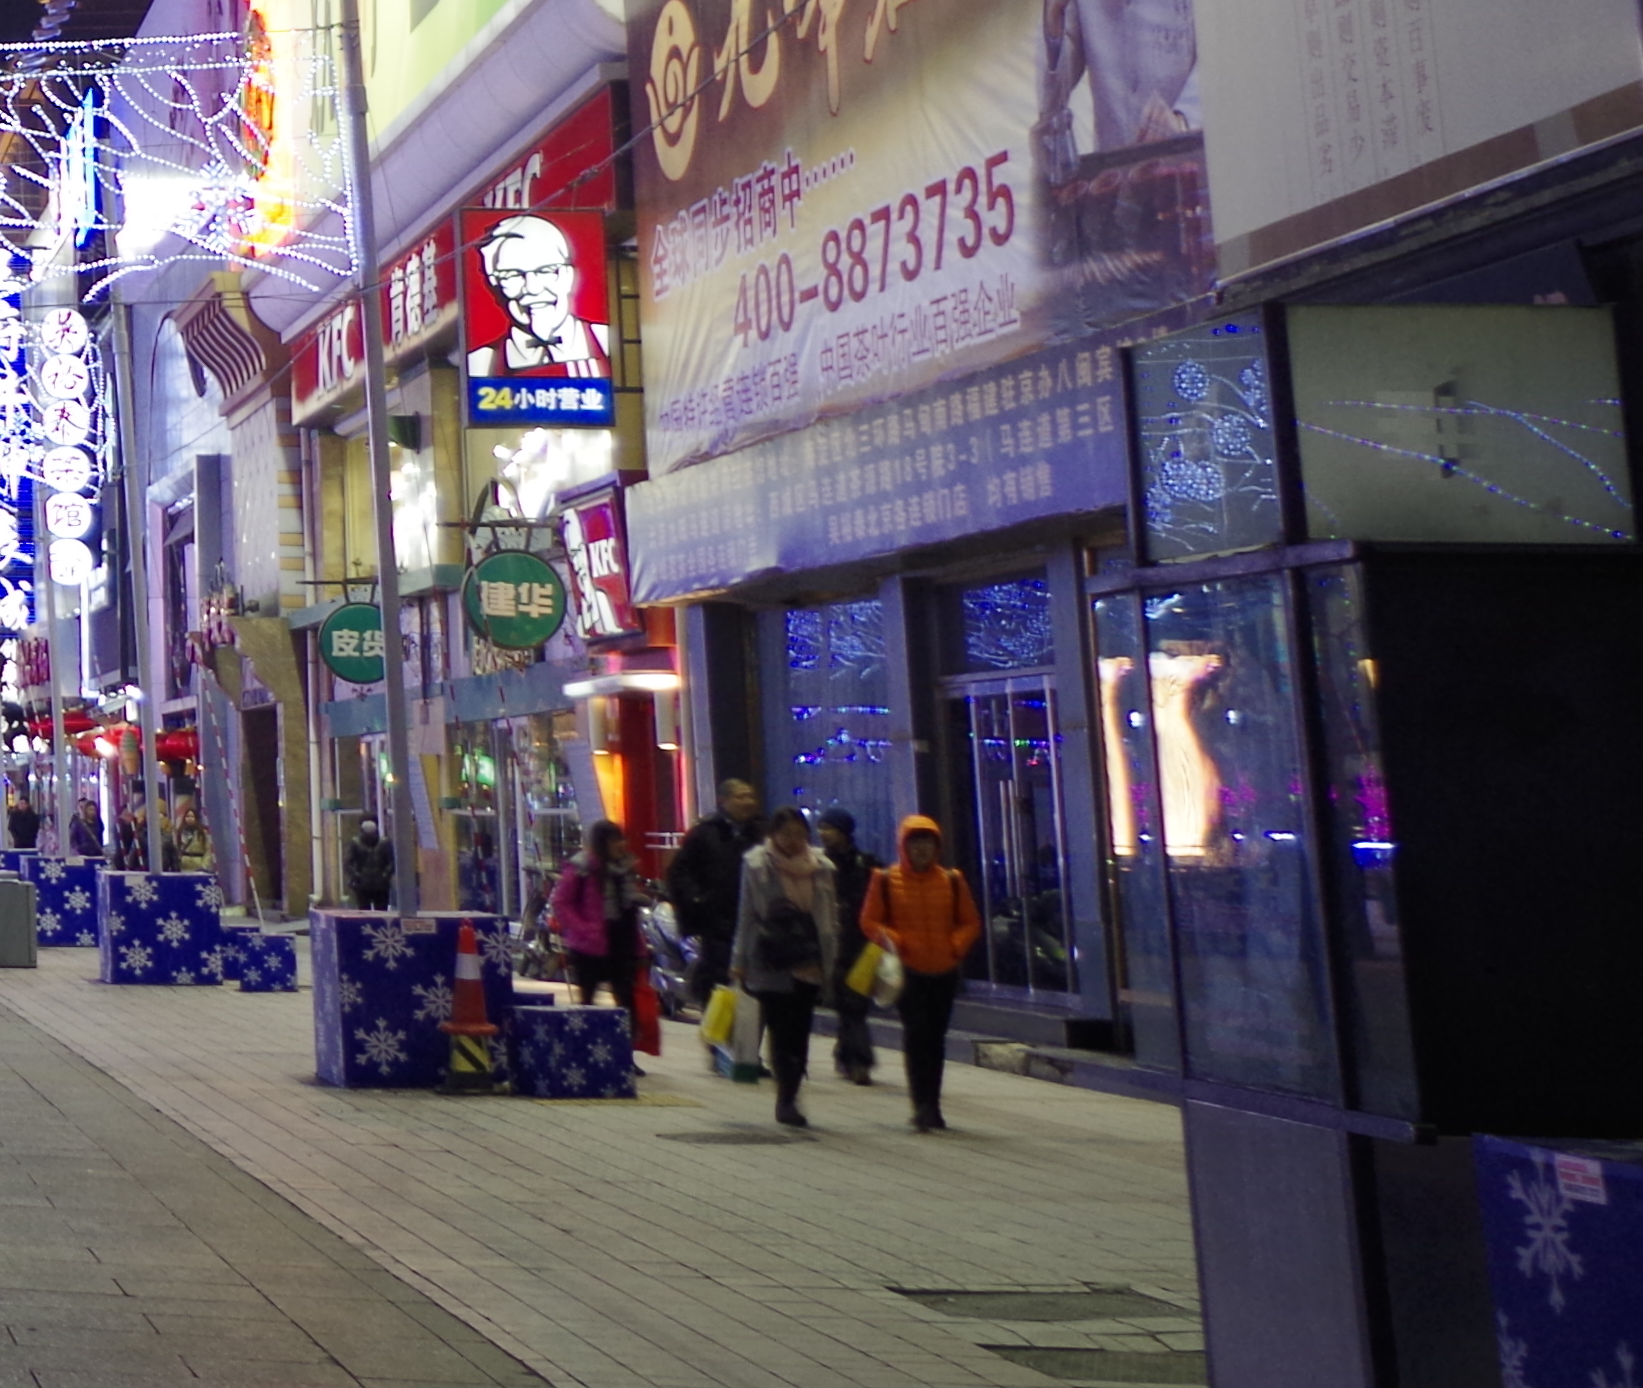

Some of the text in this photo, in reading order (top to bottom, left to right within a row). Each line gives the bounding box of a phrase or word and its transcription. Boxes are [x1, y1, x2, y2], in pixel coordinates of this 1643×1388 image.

[733, 150, 1016, 349] 400-8873735
[317, 237, 438, 398] KFC 肯德基
[817, 271, 1020, 399] 中国茶叶行业百强企业
[477, 383, 604, 412] 24小时营业
[480, 580, 554, 619] 建华
[588, 537, 620, 578] KFC
